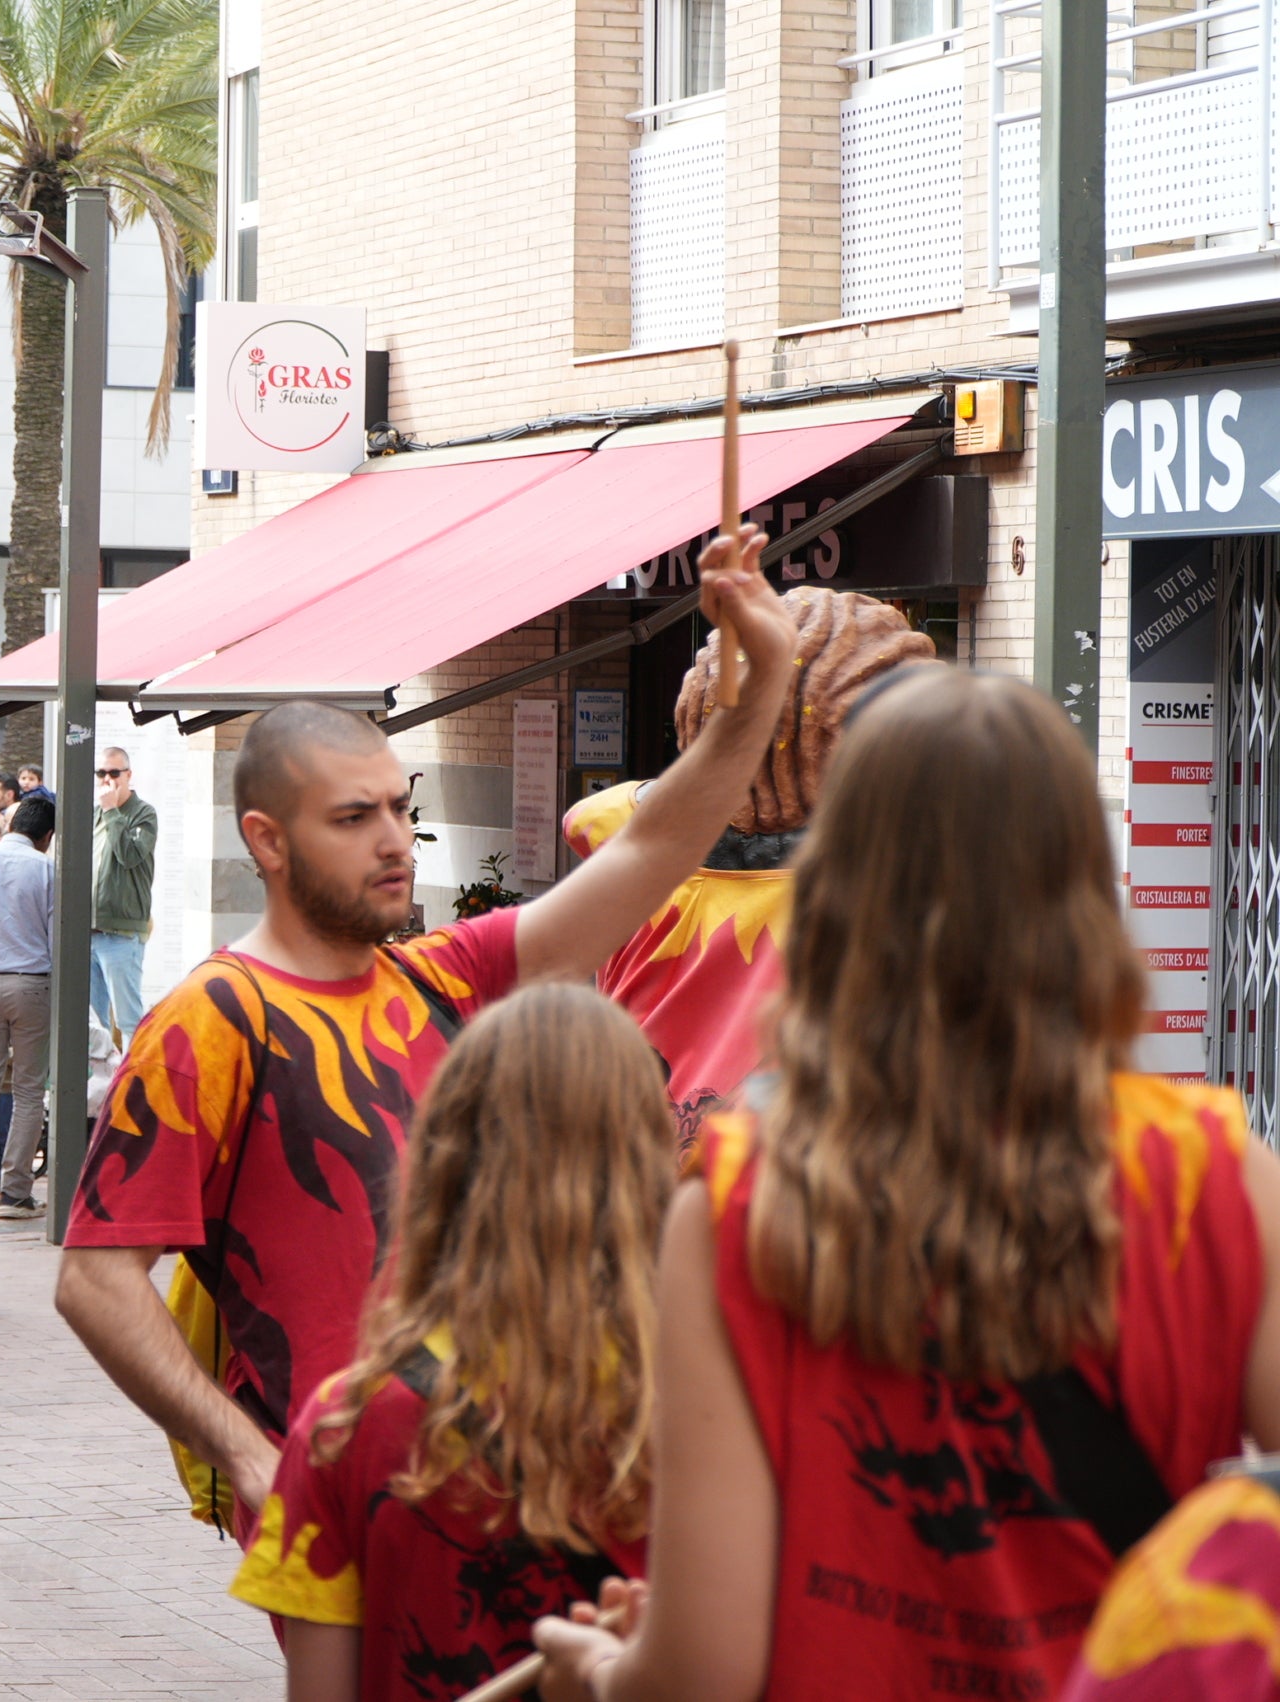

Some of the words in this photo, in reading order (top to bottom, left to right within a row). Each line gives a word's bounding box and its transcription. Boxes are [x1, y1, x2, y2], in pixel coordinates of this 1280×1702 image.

[267, 364, 352, 390] GRAS
[279, 389, 338, 405] Floristes
[1102, 388, 1246, 519] CRIS
[1154, 577, 1180, 604] TOT
[1176, 564, 1197, 588] EN
[1134, 605, 1189, 653] FUSTERIA
[592, 712, 621, 723] NEXT
[590, 733, 609, 742] 24H
[1176, 828, 1208, 842] PORTES
[1136, 890, 1192, 905] CRISTALLERIA
[1195, 890, 1206, 905] EN
[1147, 953, 1183, 967] SOSTRES
